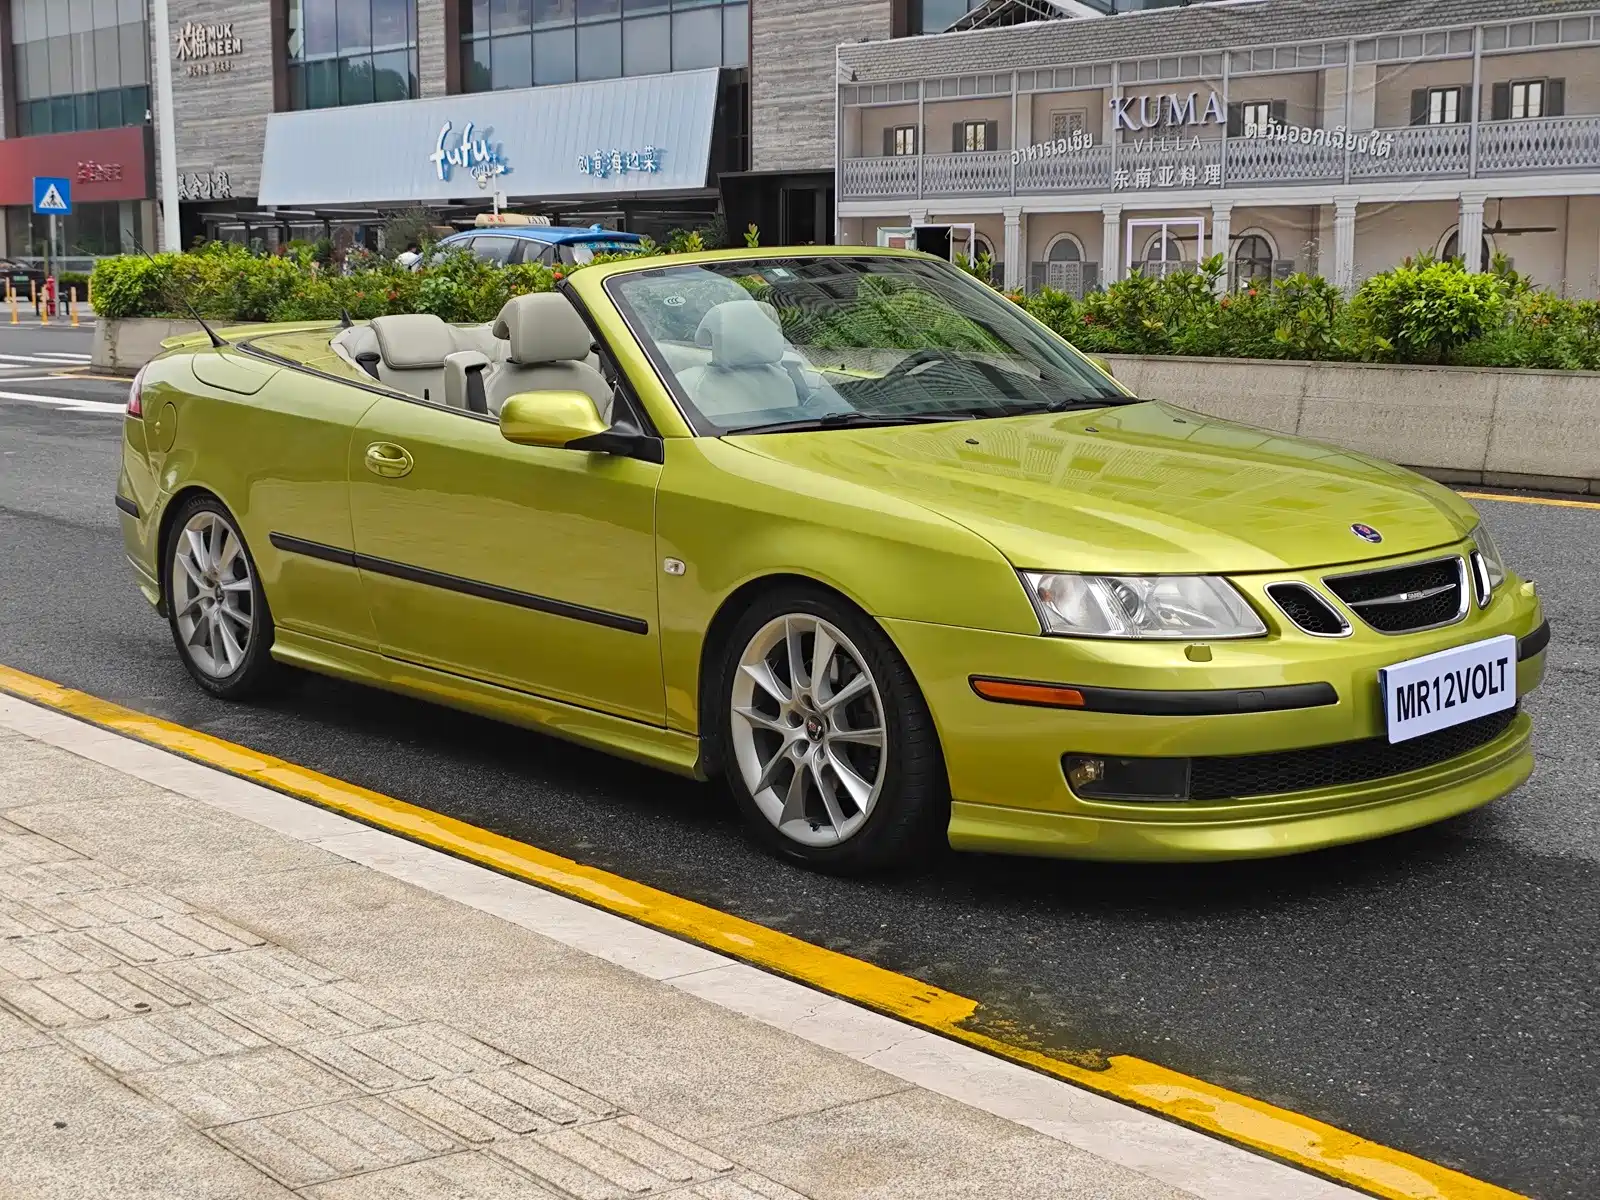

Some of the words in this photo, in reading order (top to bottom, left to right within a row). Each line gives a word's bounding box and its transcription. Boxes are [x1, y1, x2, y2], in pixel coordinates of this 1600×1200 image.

[208, 23, 233, 40] MUK
[208, 38, 242, 56] NEEM
[1109, 91, 1226, 131] KUMA
[429, 120, 491, 181] fufu
[1011, 129, 1093, 165] อาหารเอเชีย
[1133, 135, 1202, 153] VILLA
[578, 145, 657, 178] 创意海边菜
[1113, 164, 1221, 189] 东南亚料理
[525, 216, 548, 225] TAXI
[1396, 657, 1508, 722] MR12VOLT
